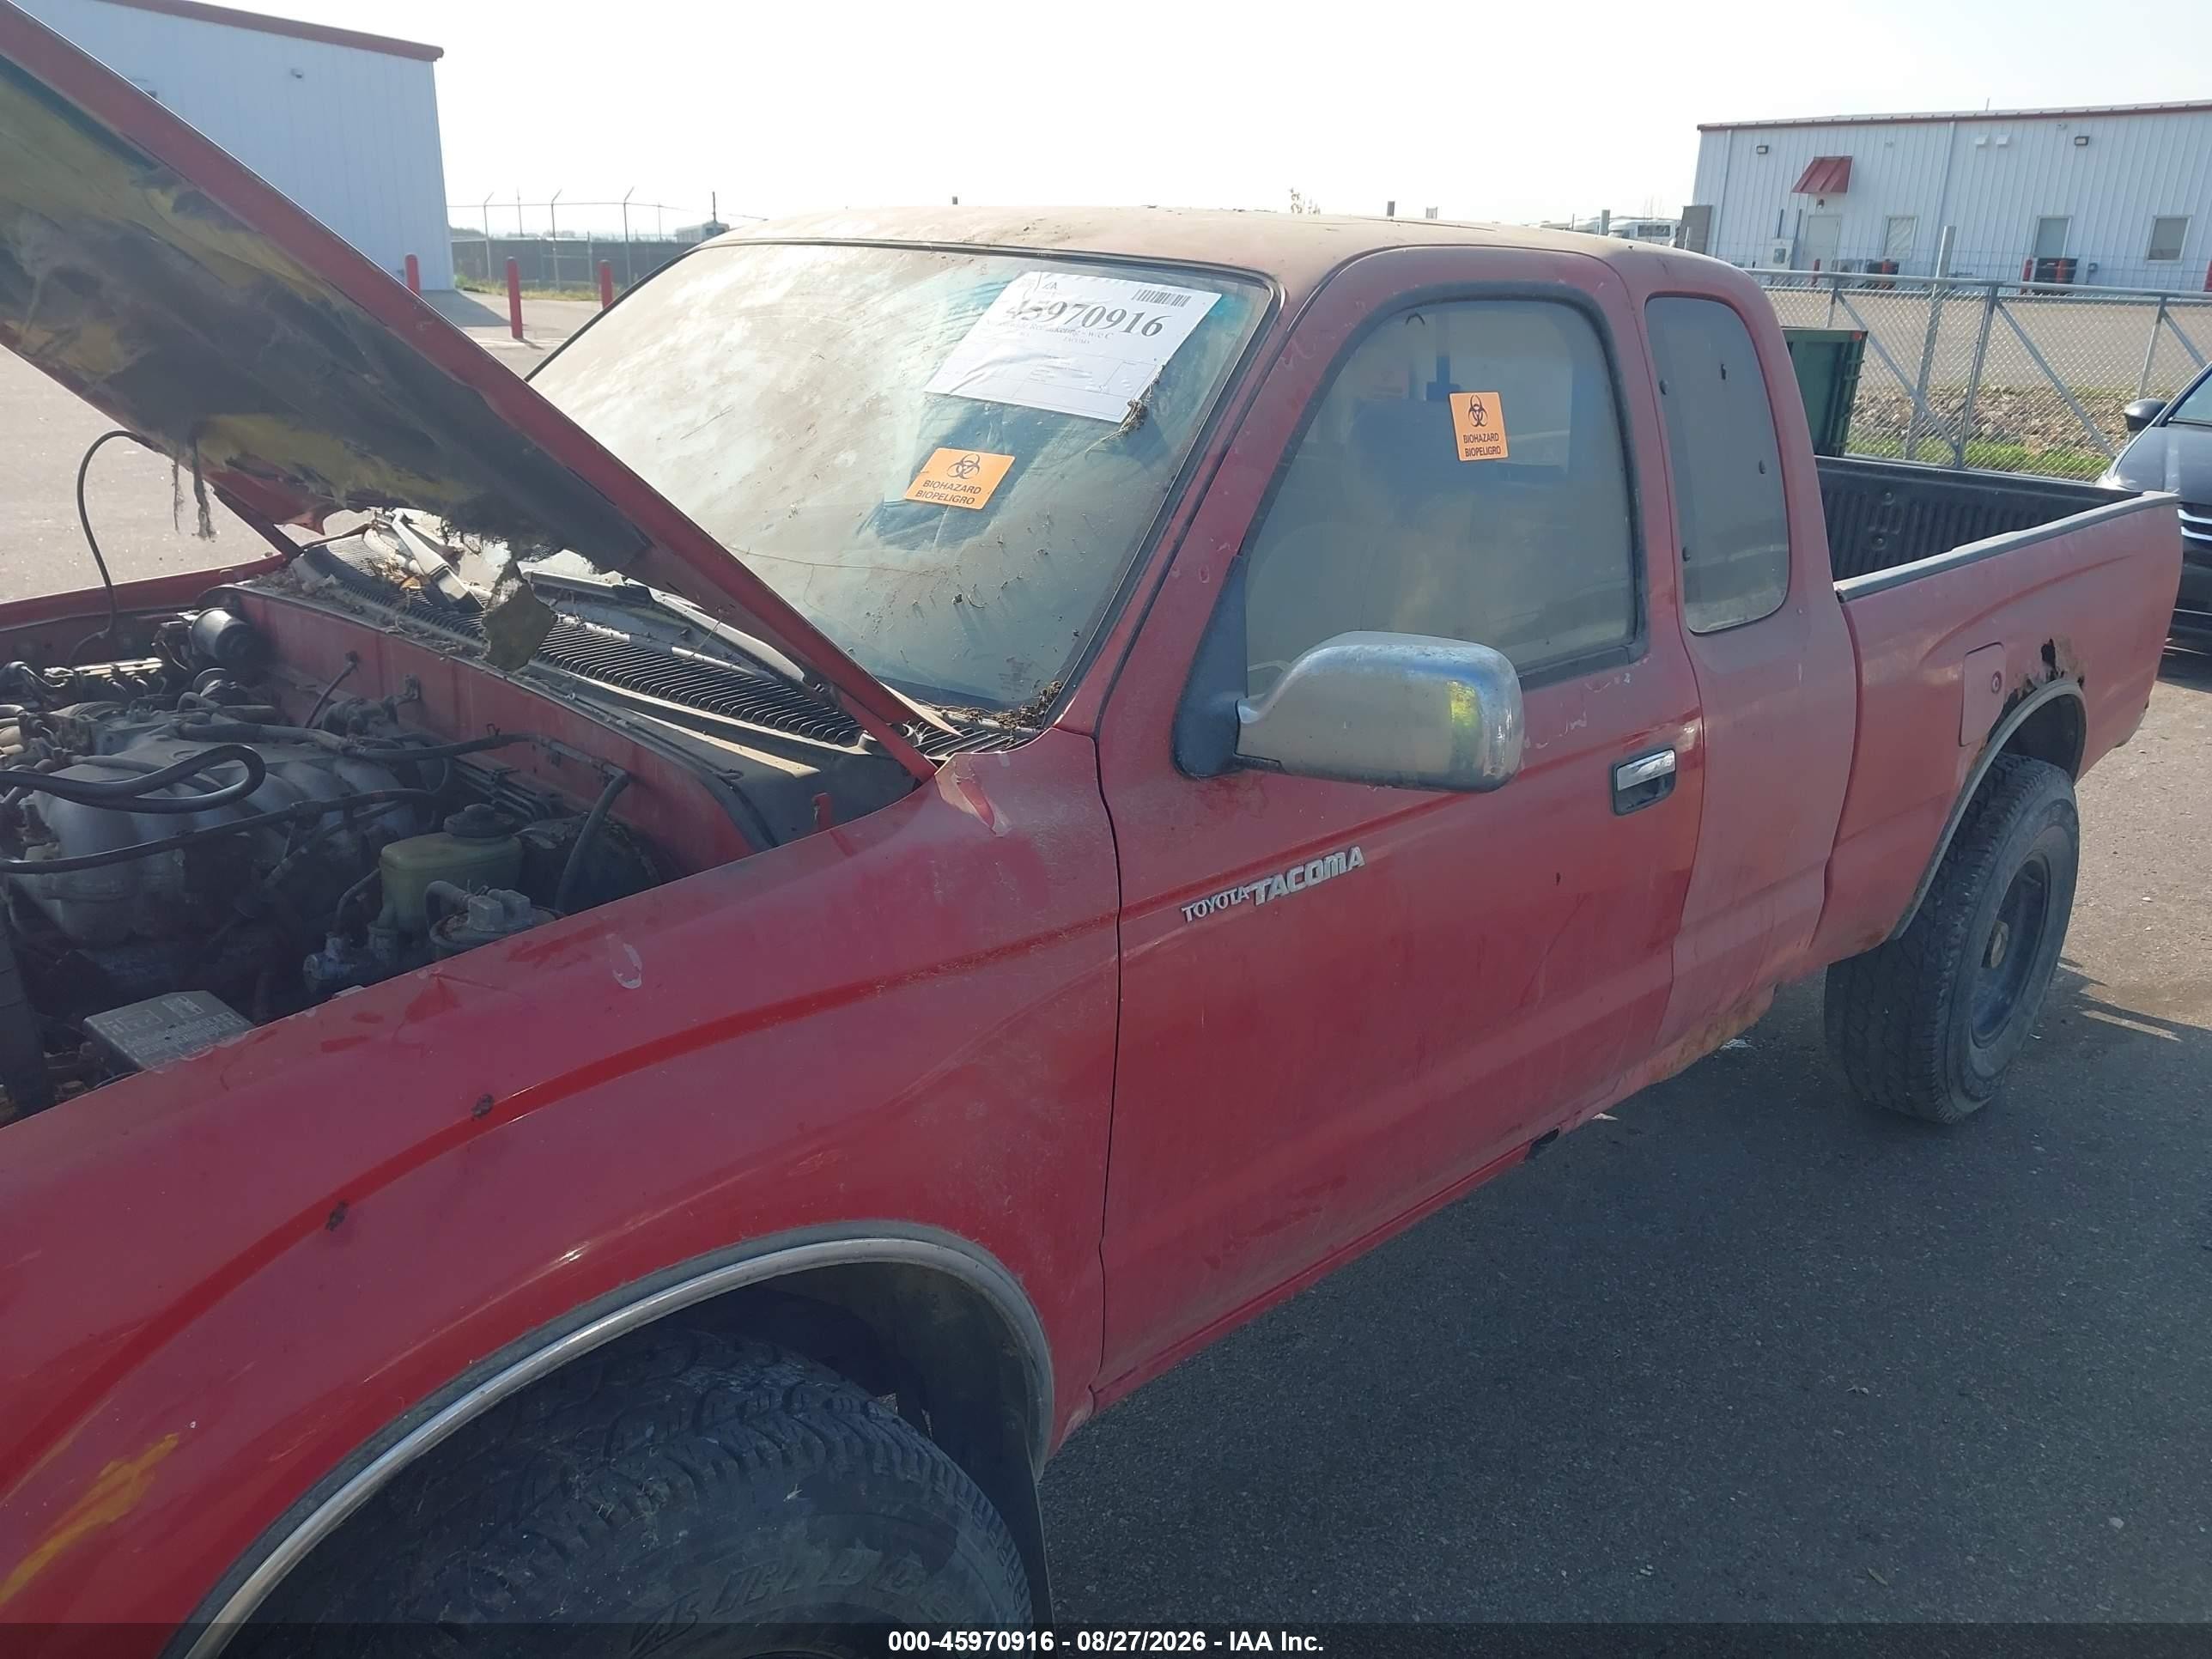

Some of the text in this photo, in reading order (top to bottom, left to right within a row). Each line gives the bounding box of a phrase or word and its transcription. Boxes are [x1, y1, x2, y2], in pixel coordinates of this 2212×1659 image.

[1463, 433, 1499, 443] BIOHAZARD
[1465, 446, 1501, 457] BIOPELIGRO
[922, 479, 981, 495] BIOHAZARD
[915, 489, 975, 505] BIOPELIGRO
[1182, 846, 1365, 922] TOYOTA TACOMA
